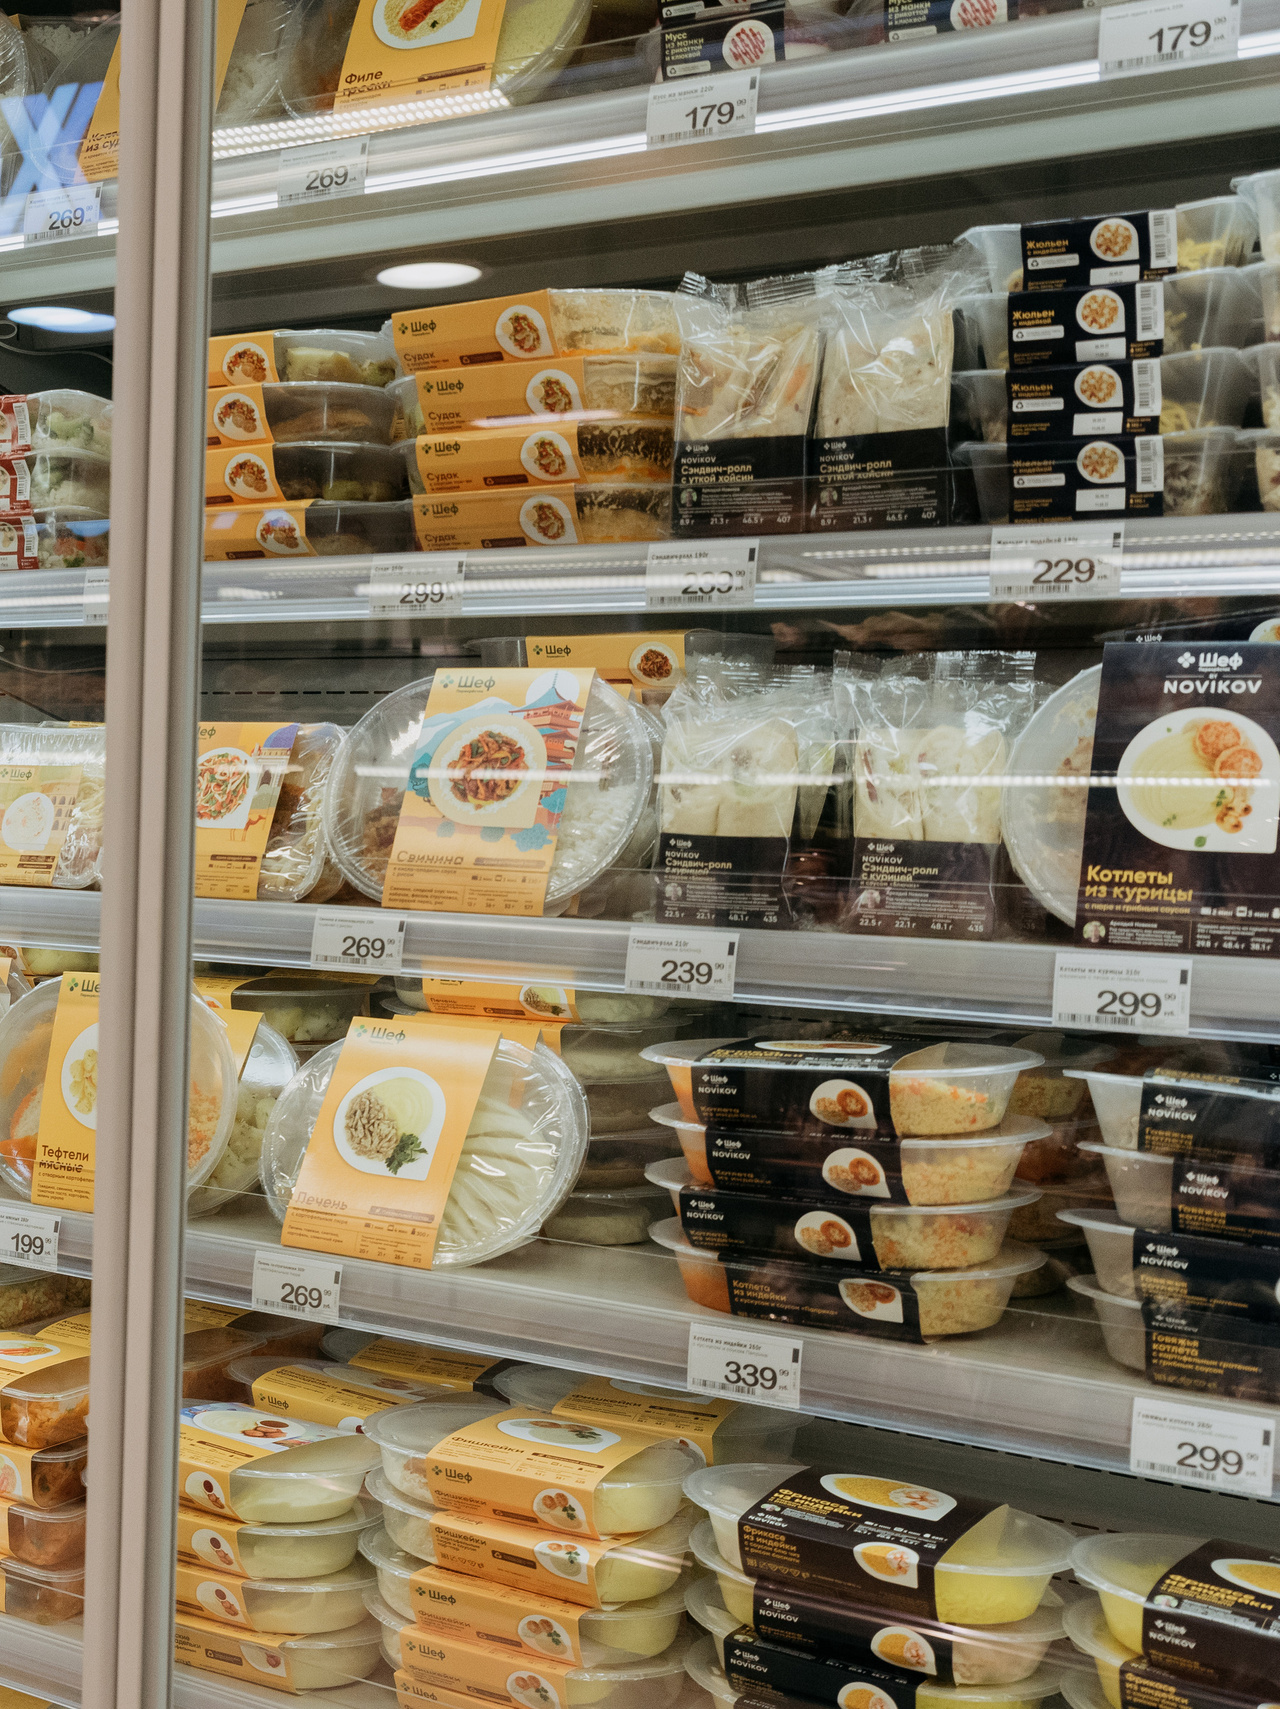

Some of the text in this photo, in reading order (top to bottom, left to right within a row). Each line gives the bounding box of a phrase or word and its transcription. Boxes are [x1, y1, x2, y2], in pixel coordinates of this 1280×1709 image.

[665, 31, 687, 42] Мусс
[1149, 21, 1211, 53] 179
[345, 70, 382, 85] Филе
[685, 101, 735, 130] 179
[306, 165, 349, 191] 269
[49, 207, 85, 231] 269
[1026, 238, 1069, 250] Жюльен
[1012, 309, 1055, 320] Жюльен
[410, 319, 437, 334] Шеф
[404, 351, 435, 363] Судак
[436, 380, 464, 393] Шеф
[1011, 382, 1053, 392] Жюльен
[428, 410, 461, 422] Судак
[434, 441, 461, 454] Шеф
[693, 443, 710, 453] Шеф
[831, 440, 847, 450] Шеф
[681, 455, 717, 464] NOVIKOV
[820, 453, 855, 463] NOVIKOV
[681, 464, 752, 475] Сэндвич-ролл
[820, 459, 892, 474] Сэндвич-ролл
[427, 471, 459, 483] Судак
[431, 503, 459, 516] Шеф
[1033, 558, 1096, 585] 229
[545, 644, 571, 658] Шеф
[1198, 651, 1243, 670] Шеф
[457, 675, 495, 692] Шеф
[1163, 679, 1262, 694] NOVIKOV
[10, 767, 32, 781] Шеф
[397, 850, 464, 866] Свинина
[665, 858, 732, 871] Сэндвич-ролл
[862, 855, 902, 864] NOVIKOV
[862, 862, 938, 876] Сэндвич-ролл
[1087, 865, 1173, 885] Котлеты
[1085, 885, 1193, 904] из курицы
[342, 936, 385, 959] 269
[661, 960, 713, 985] 239
[81, 978, 100, 994] Ше
[1097, 990, 1162, 1018] 299
[370, 1025, 406, 1044] Шеф
[698, 1086, 737, 1095] NOVIKOV
[1148, 1108, 1197, 1122] NOVIKOV
[42, 1144, 89, 1162] Тефтели
[712, 1151, 751, 1160] NOVIKOV
[1179, 1185, 1229, 1199] NOVIKOV
[296, 1191, 348, 1211] Печень
[686, 1211, 724, 1221] NOVIKOV
[11, 1232, 44, 1256] 199
[1140, 1256, 1188, 1270] NOVIKOV
[733, 1280, 770, 1292] Котлета
[281, 1282, 322, 1309] 269
[746, 1290, 787, 1302] индейки
[724, 1361, 778, 1390] 339
[1176, 1441, 1243, 1475] 299
[445, 1467, 473, 1485] Шеф
[434, 1526, 487, 1547] Фишкейки
[743, 1525, 786, 1542] Фрикасе
[428, 1589, 457, 1606] Шеф
[759, 1608, 799, 1624] NOVIKOV
[1148, 1631, 1197, 1649] NOVIKOV
[418, 1643, 446, 1661] Шеф
[730, 1658, 768, 1673] NOVIKOV
